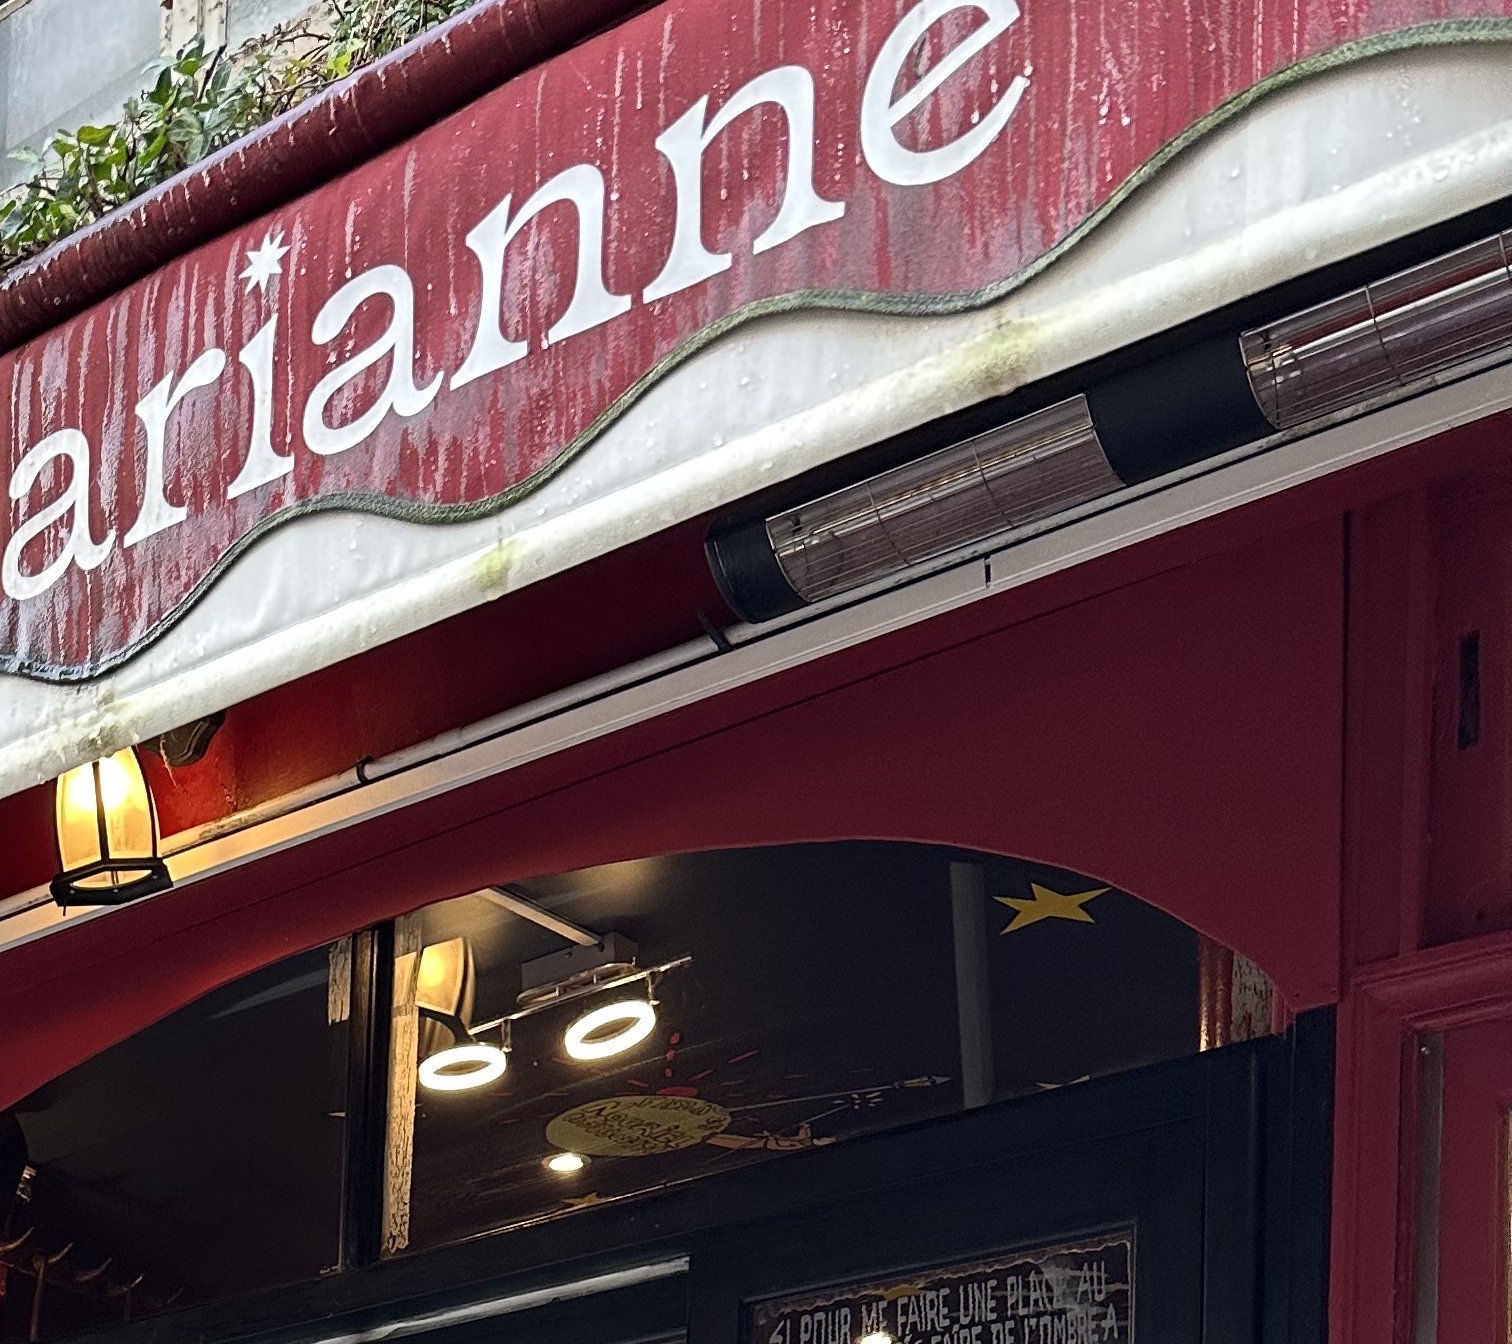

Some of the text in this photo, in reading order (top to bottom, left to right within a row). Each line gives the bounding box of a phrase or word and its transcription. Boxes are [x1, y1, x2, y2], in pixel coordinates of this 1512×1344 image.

[897, 1287, 950, 1337] FAIRE
[959, 1279, 997, 1324] UNE
[1077, 1260, 1105, 1303] AU
